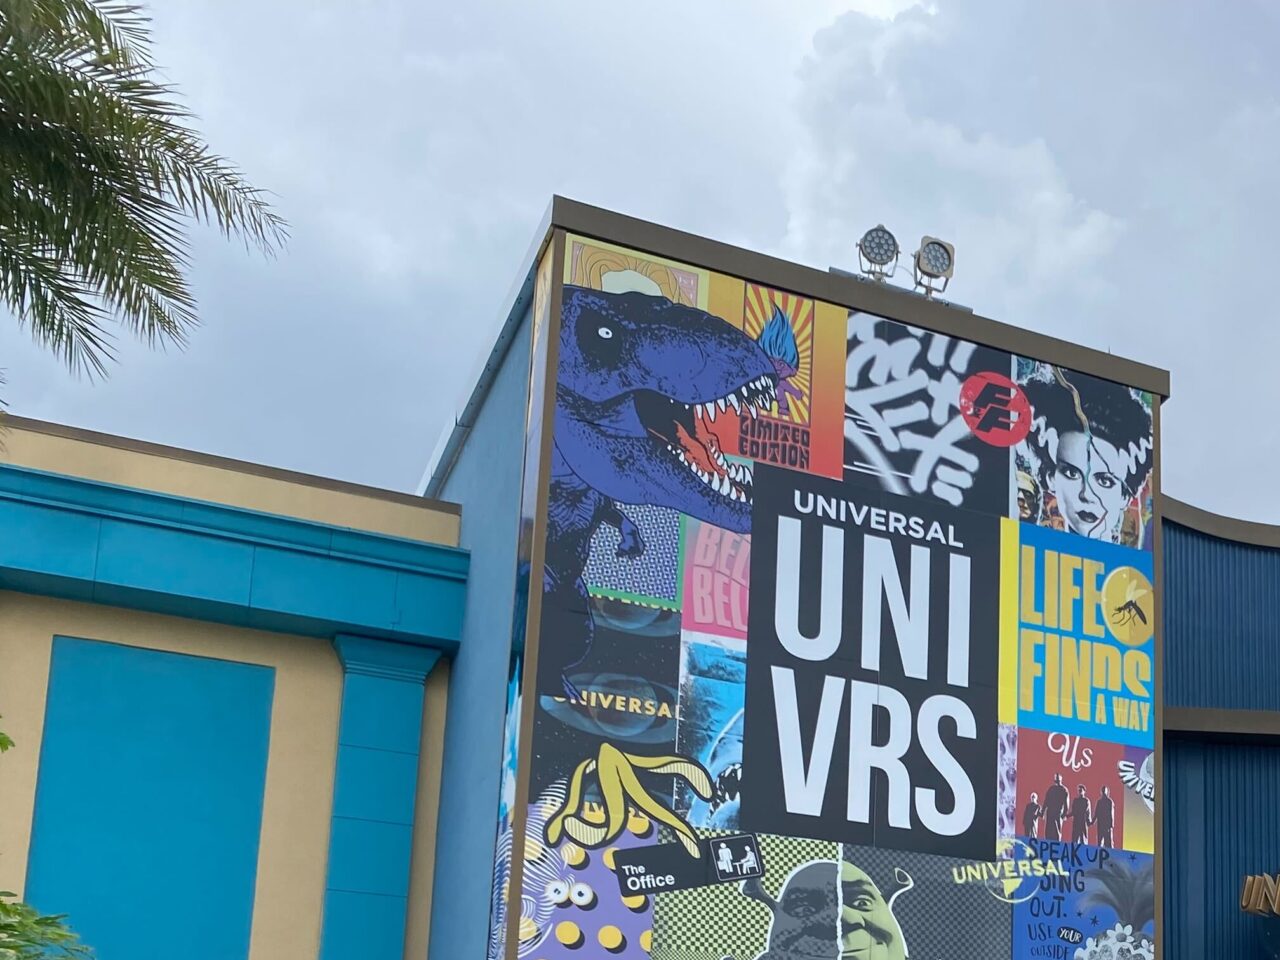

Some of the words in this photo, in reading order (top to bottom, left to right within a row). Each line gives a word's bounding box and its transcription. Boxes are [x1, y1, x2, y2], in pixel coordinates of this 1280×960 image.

[740, 413, 810, 447] LIMITED
[739, 435, 810, 470] EDITION
[794, 489, 964, 548] UNIVERSAL
[775, 515, 971, 689] UNI
[1021, 544, 1105, 638] LIFE
[1095, 693, 1107, 725] A
[1112, 696, 1150, 732] WAY
[770, 665, 977, 837] VRS
[1047, 731, 1094, 772] Us
[1117, 760, 1154, 801] UNIVE
[621, 864, 646, 876] The
[952, 858, 1070, 884] UNIVERSAL
[1027, 838, 1083, 868] SPEAK
[626, 874, 675, 891] Office
[1028, 922, 1054, 941] USE
[1059, 927, 1082, 943] YOUR
